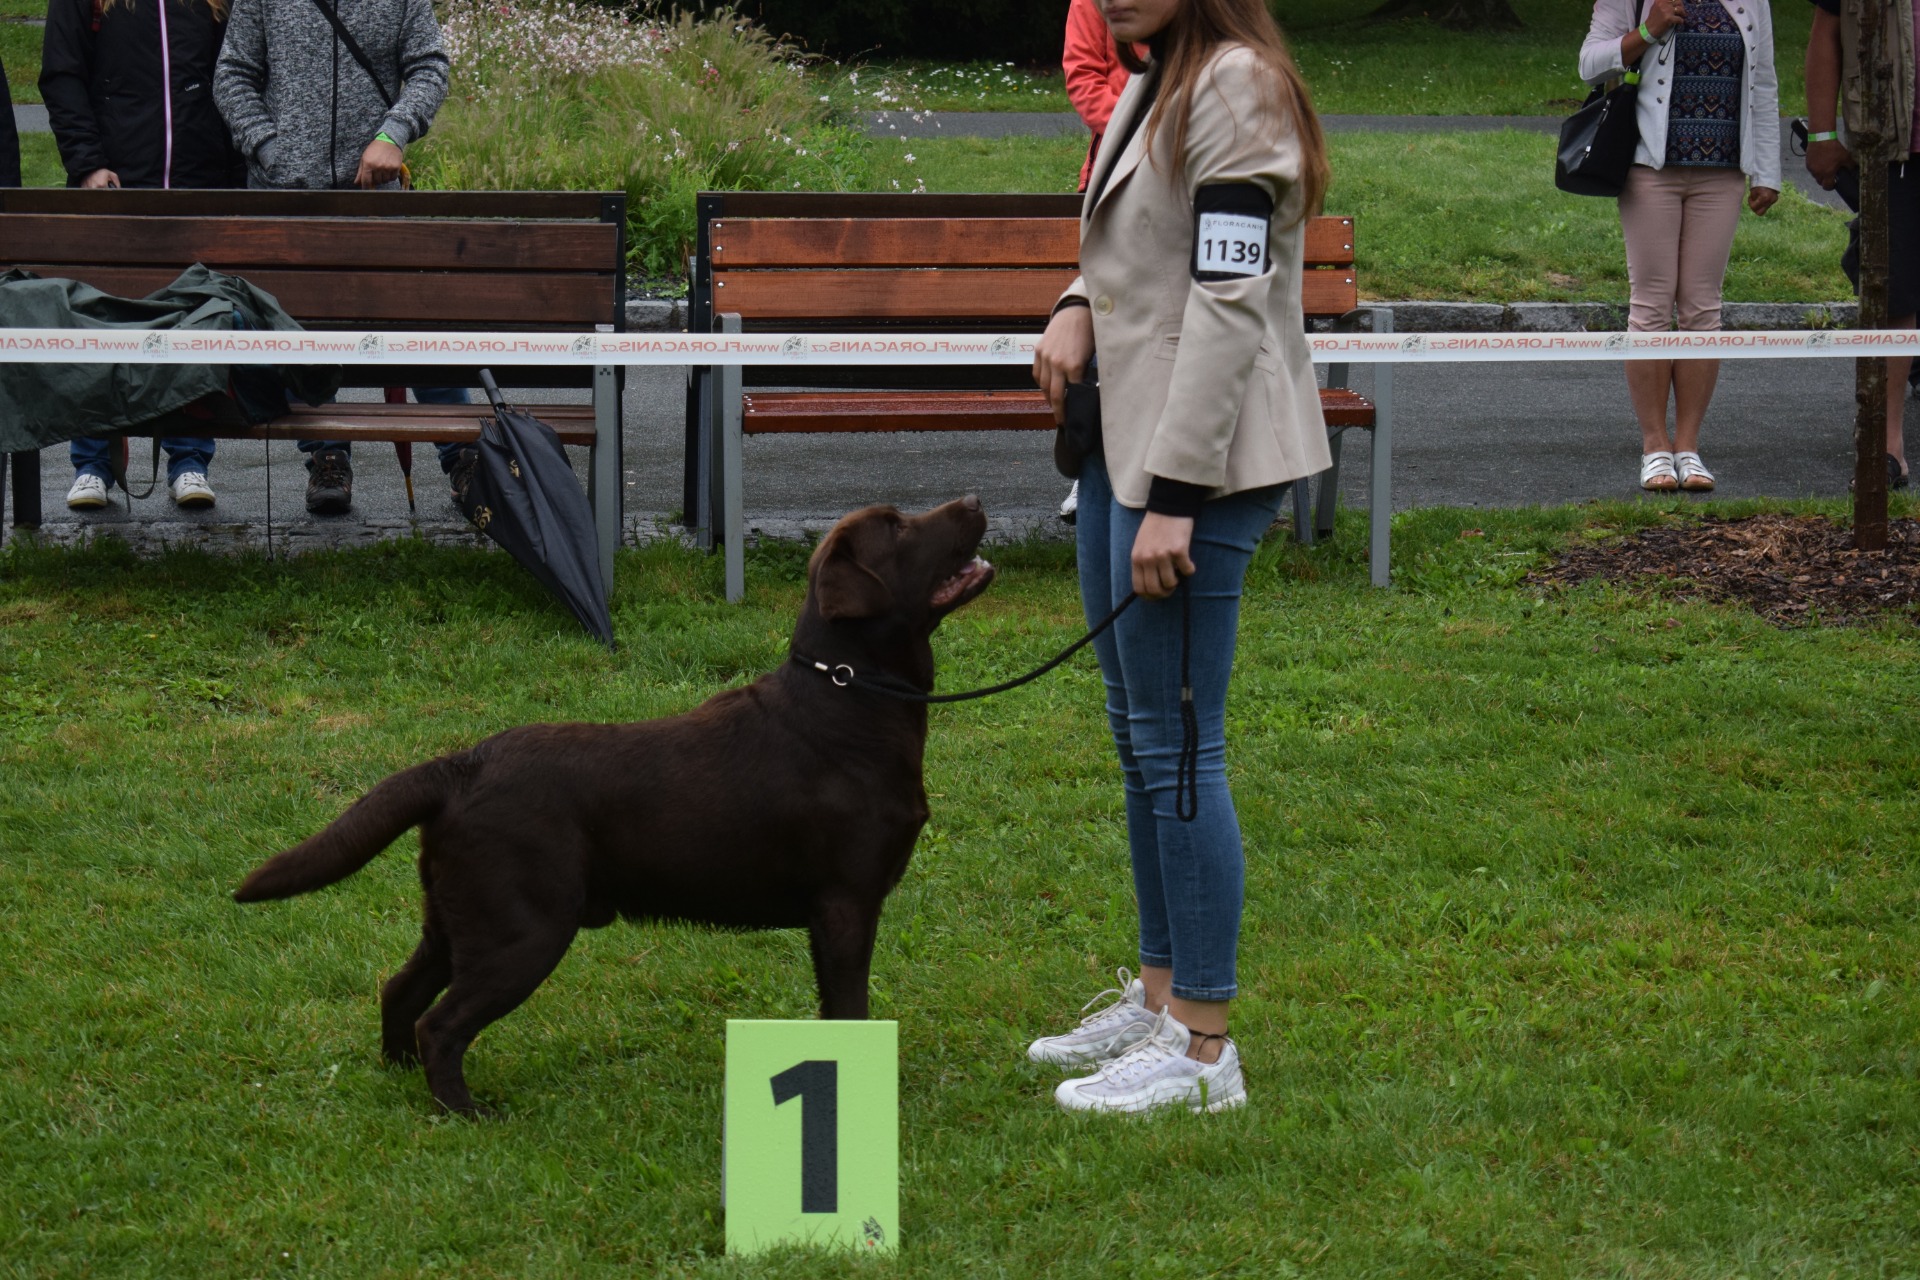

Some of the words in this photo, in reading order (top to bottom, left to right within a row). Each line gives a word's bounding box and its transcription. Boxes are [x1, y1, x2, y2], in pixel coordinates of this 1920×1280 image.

[1213, 220, 1264, 231] FLORACANIS
[1204, 238, 1261, 265] 1139
[770, 1060, 838, 1213] 1
